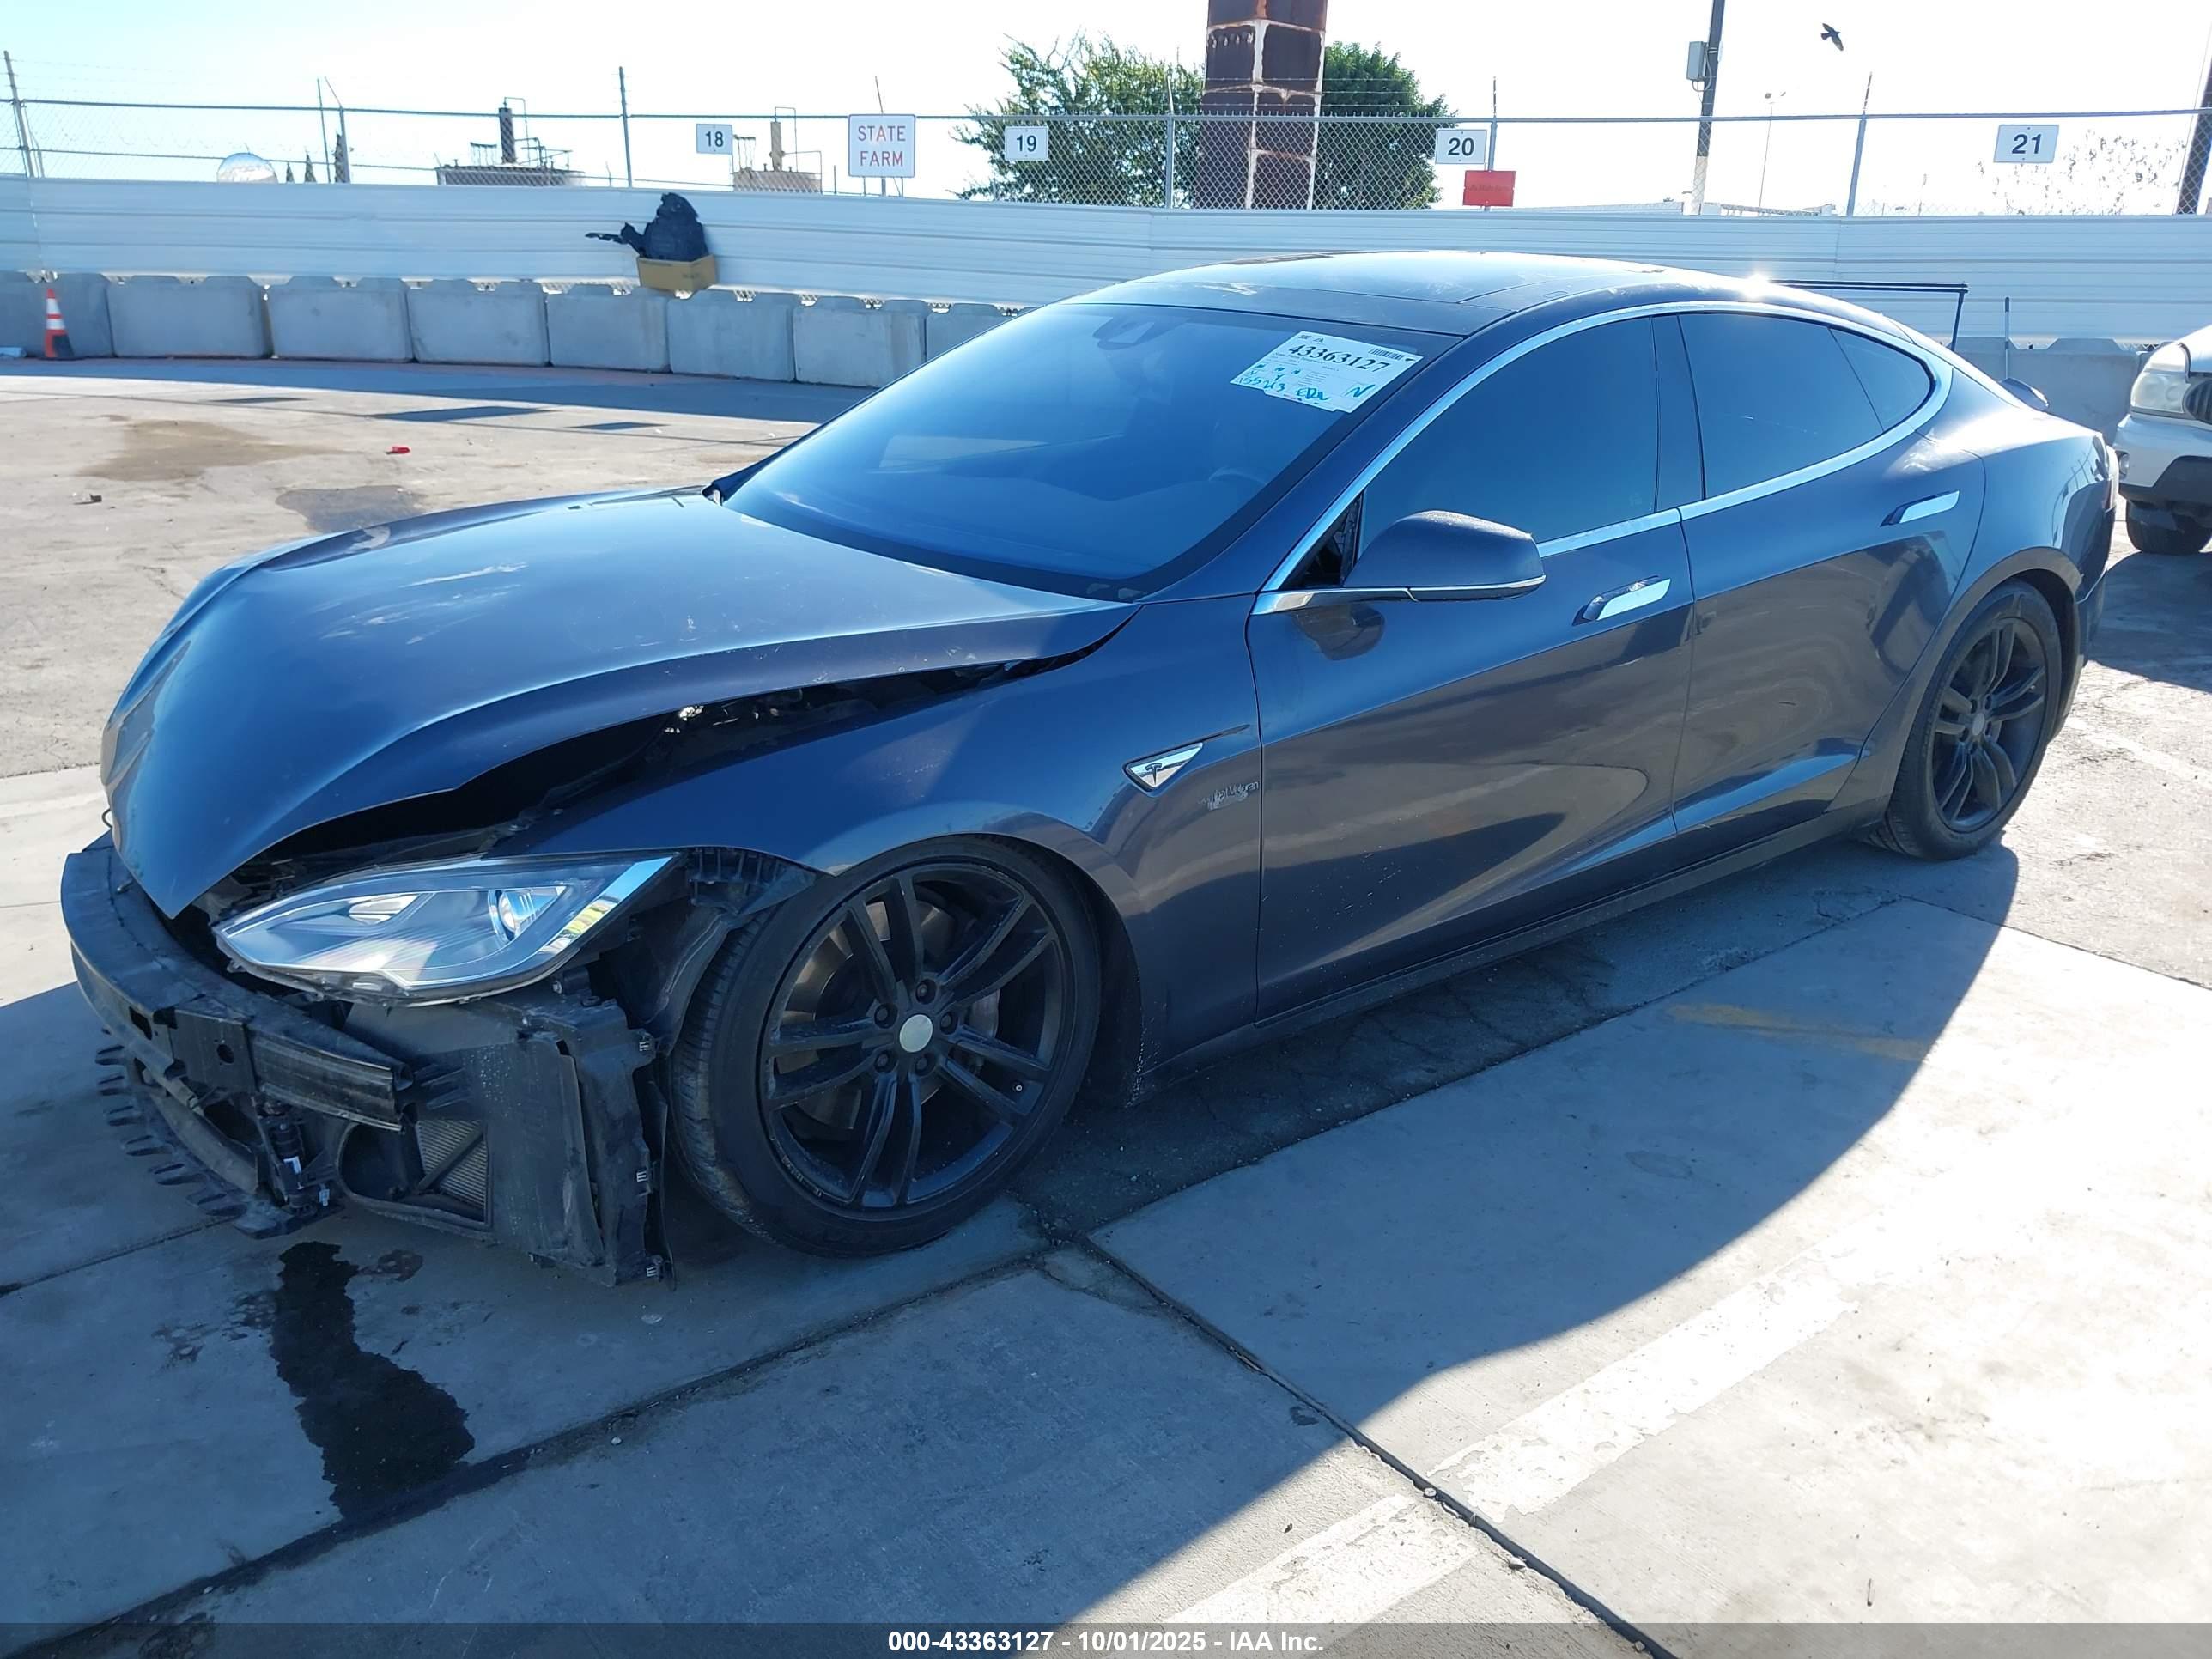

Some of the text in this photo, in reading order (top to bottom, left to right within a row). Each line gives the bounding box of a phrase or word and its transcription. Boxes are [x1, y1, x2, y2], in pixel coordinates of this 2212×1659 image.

[705, 131, 724, 148] 18
[858, 125, 906, 142] STATE
[1016, 134, 1037, 153] 19
[1447, 137, 1474, 157] 20
[2011, 133, 2042, 155] 21
[860, 150, 903, 167] FARM
[1288, 344, 1391, 373] 43363127
